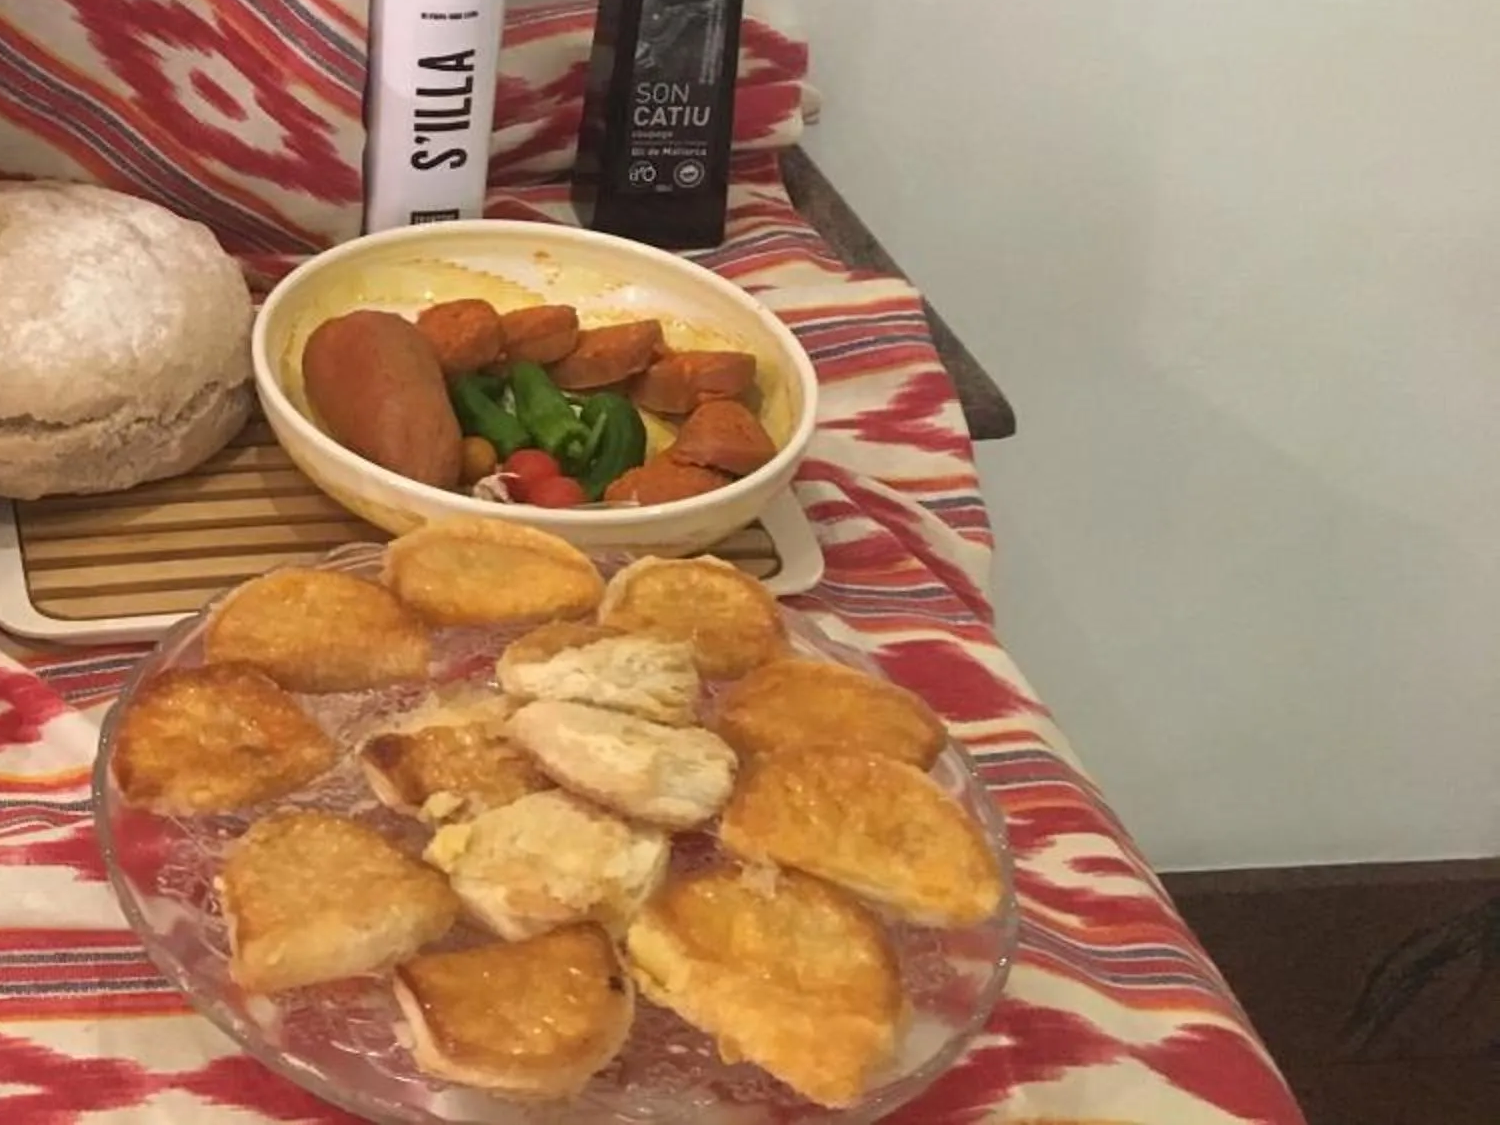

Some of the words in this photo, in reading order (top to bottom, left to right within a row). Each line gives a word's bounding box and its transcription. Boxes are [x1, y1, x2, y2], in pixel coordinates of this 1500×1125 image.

[636, 82, 690, 104] SON
[410, 49, 475, 170] S'ILLA
[633, 105, 711, 126] CATIU
